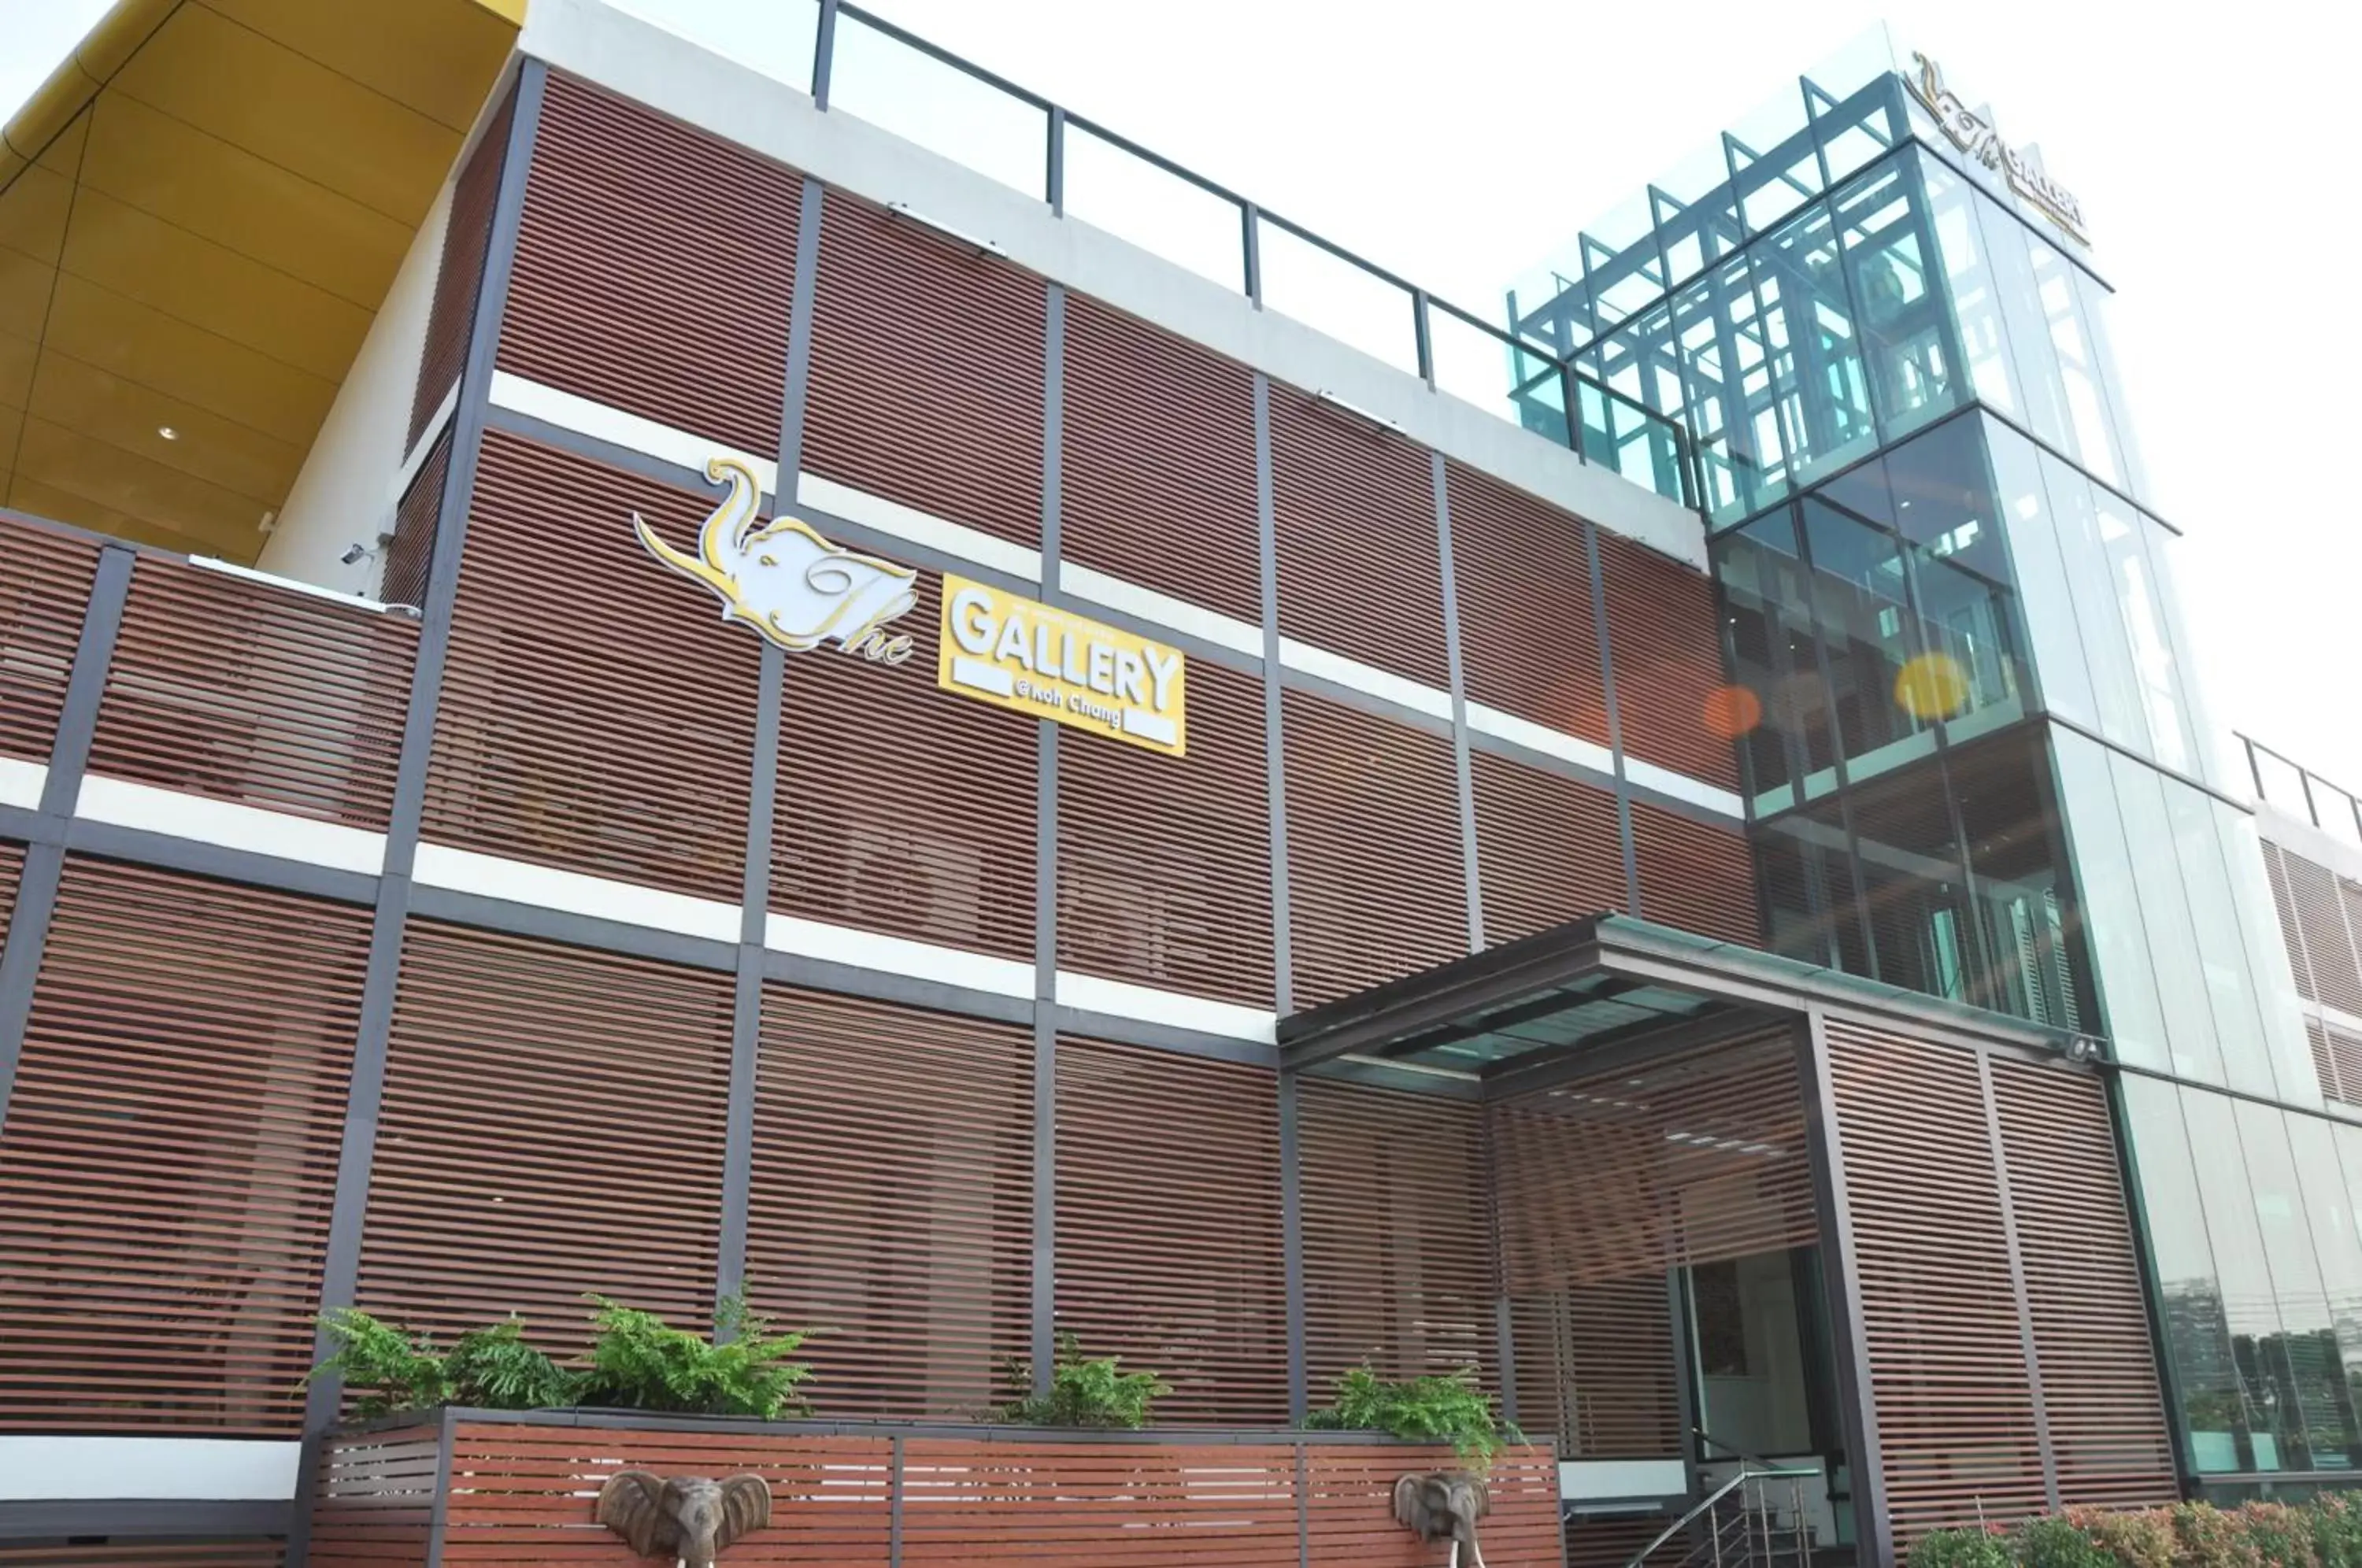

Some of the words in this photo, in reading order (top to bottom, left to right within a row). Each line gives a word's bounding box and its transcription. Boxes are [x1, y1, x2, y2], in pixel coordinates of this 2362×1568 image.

[950, 587, 1179, 712] GALLERY
[1015, 679, 1062, 708] @Koh
[1068, 693, 1120, 730] Chang
